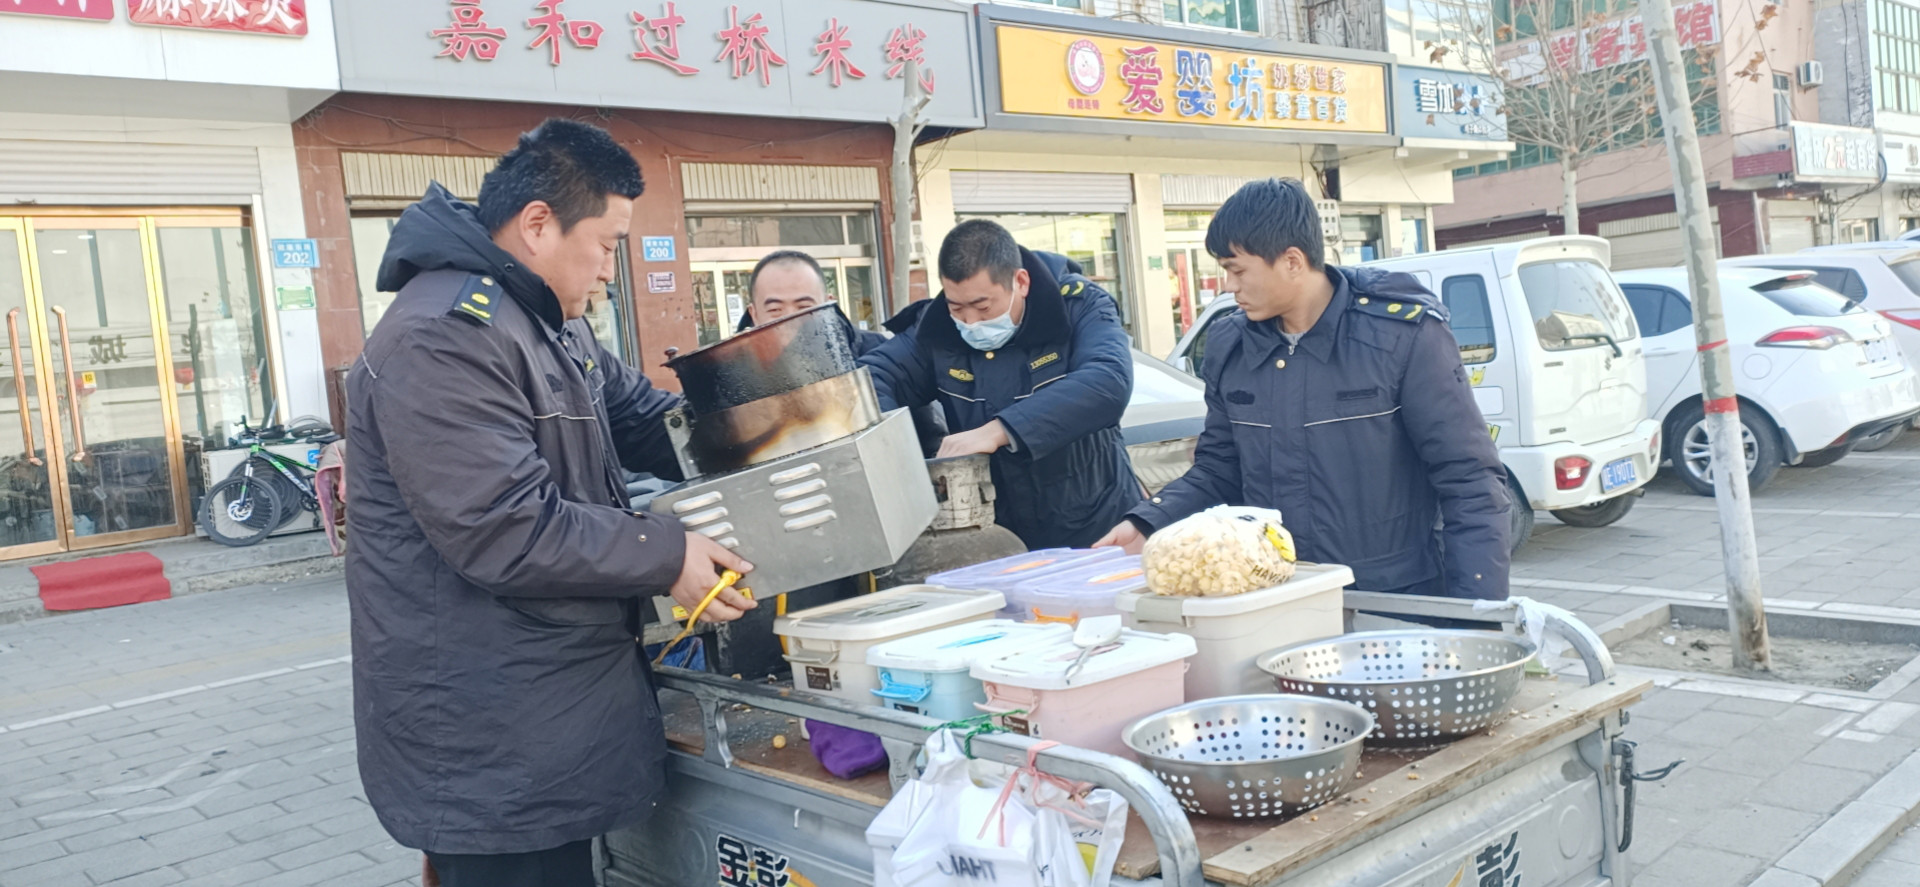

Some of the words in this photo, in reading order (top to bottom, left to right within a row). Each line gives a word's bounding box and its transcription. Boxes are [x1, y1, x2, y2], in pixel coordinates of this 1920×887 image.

[430, 0, 935, 94] 嘉和过桥米线
[1121, 45, 1264, 120] 爱婴坊
[1271, 63, 1346, 93] 奶粉世家
[1274, 92, 1347, 122] 婴童百货
[283, 252, 310, 264] 202
[649, 247, 669, 258] 200
